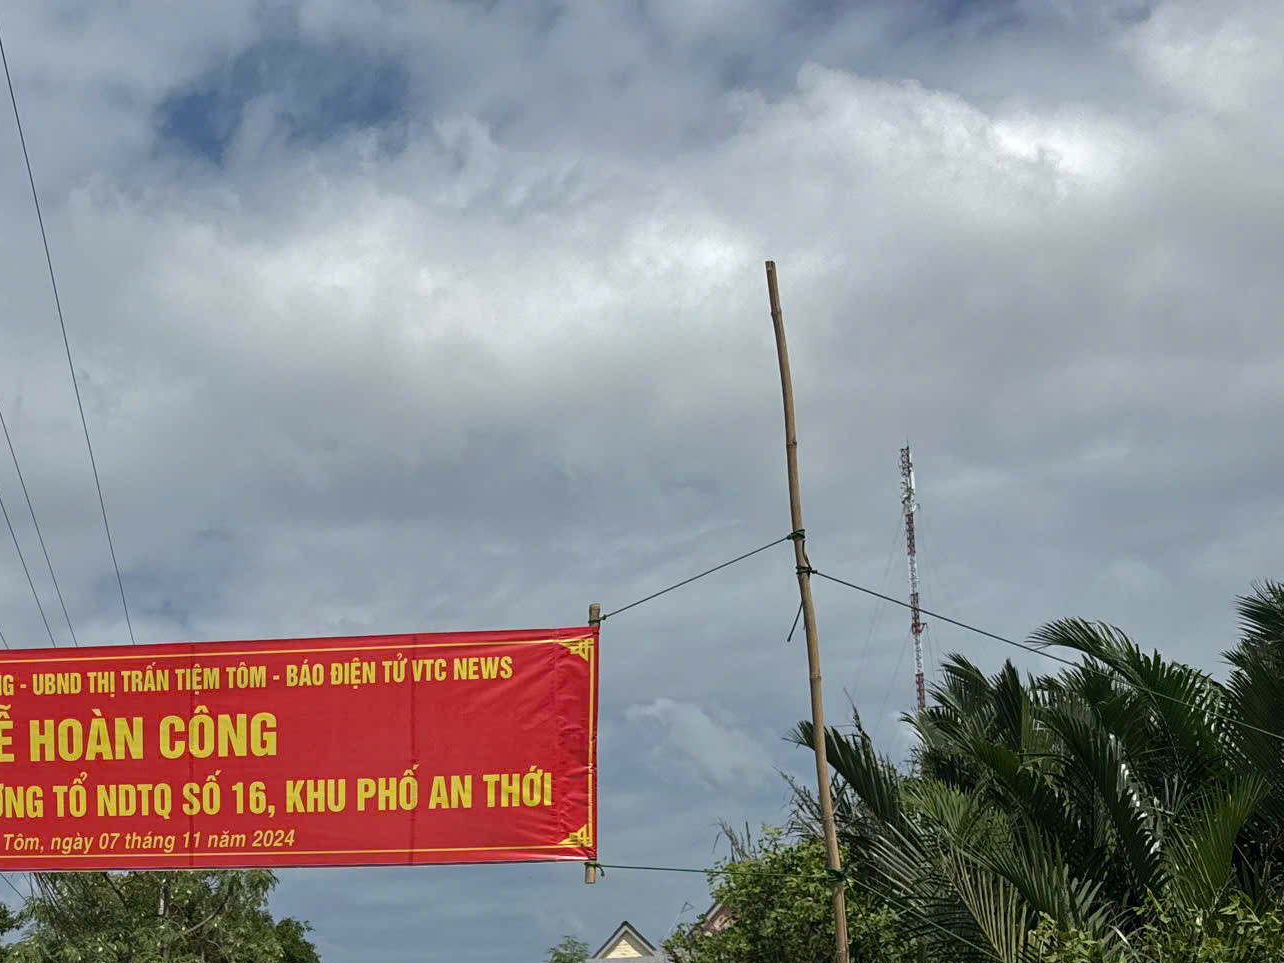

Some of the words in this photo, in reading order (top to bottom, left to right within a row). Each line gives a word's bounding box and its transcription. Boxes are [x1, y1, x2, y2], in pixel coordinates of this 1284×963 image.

[32, 673, 82, 696] UBND
[87, 671, 116, 698] THỊ
[120, 662, 170, 692] TRẤN
[174, 663, 220, 695] TIỆM
[225, 661, 267, 689] TÔM
[286, 659, 325, 687] BÁO
[329, 657, 376, 689] ĐIỆN
[381, 652, 409, 683] TỬ
[411, 658, 447, 682] VTC
[453, 655, 513, 681] NEWS
[29, 708, 144, 762] HOÀN
[159, 705, 277, 760] CÔNG
[53, 771, 88, 817] TỔ
[96, 784, 172, 820] NDTQ
[182, 770, 221, 816] SỐ
[231, 781, 276, 818] 16,
[285, 778, 346, 813] KHU
[356, 764, 420, 812] PHỐ
[428, 775, 473, 810] AN
[482, 765, 553, 808] THỚI
[3, 832, 44, 853] Tôm,
[51, 833, 94, 855] ngày
[99, 832, 120, 850] 07
[124, 831, 175, 854] tháng
[182, 832, 201, 849] 11
[207, 831, 247, 849] năm
[252, 829, 295, 848] 2024
